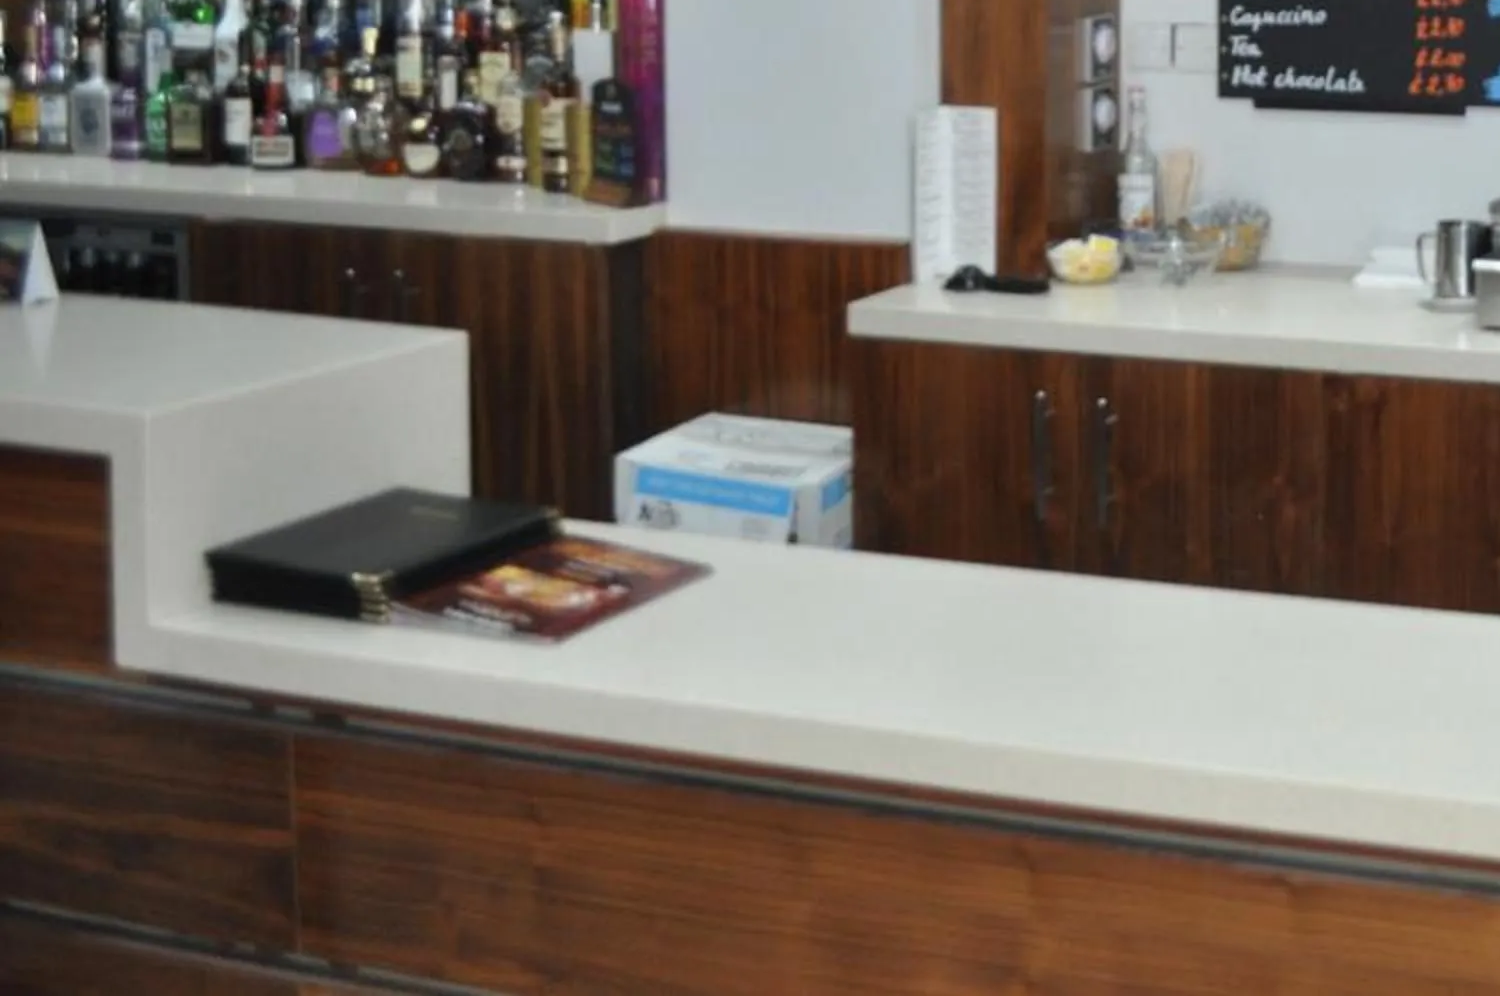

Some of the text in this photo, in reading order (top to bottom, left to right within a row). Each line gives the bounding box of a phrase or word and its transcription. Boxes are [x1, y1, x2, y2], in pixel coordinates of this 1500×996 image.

[1229, 35, 1263, 57] Tea
[1231, 63, 1268, 88] Hot
[1273, 65, 1366, 93] chocolate
